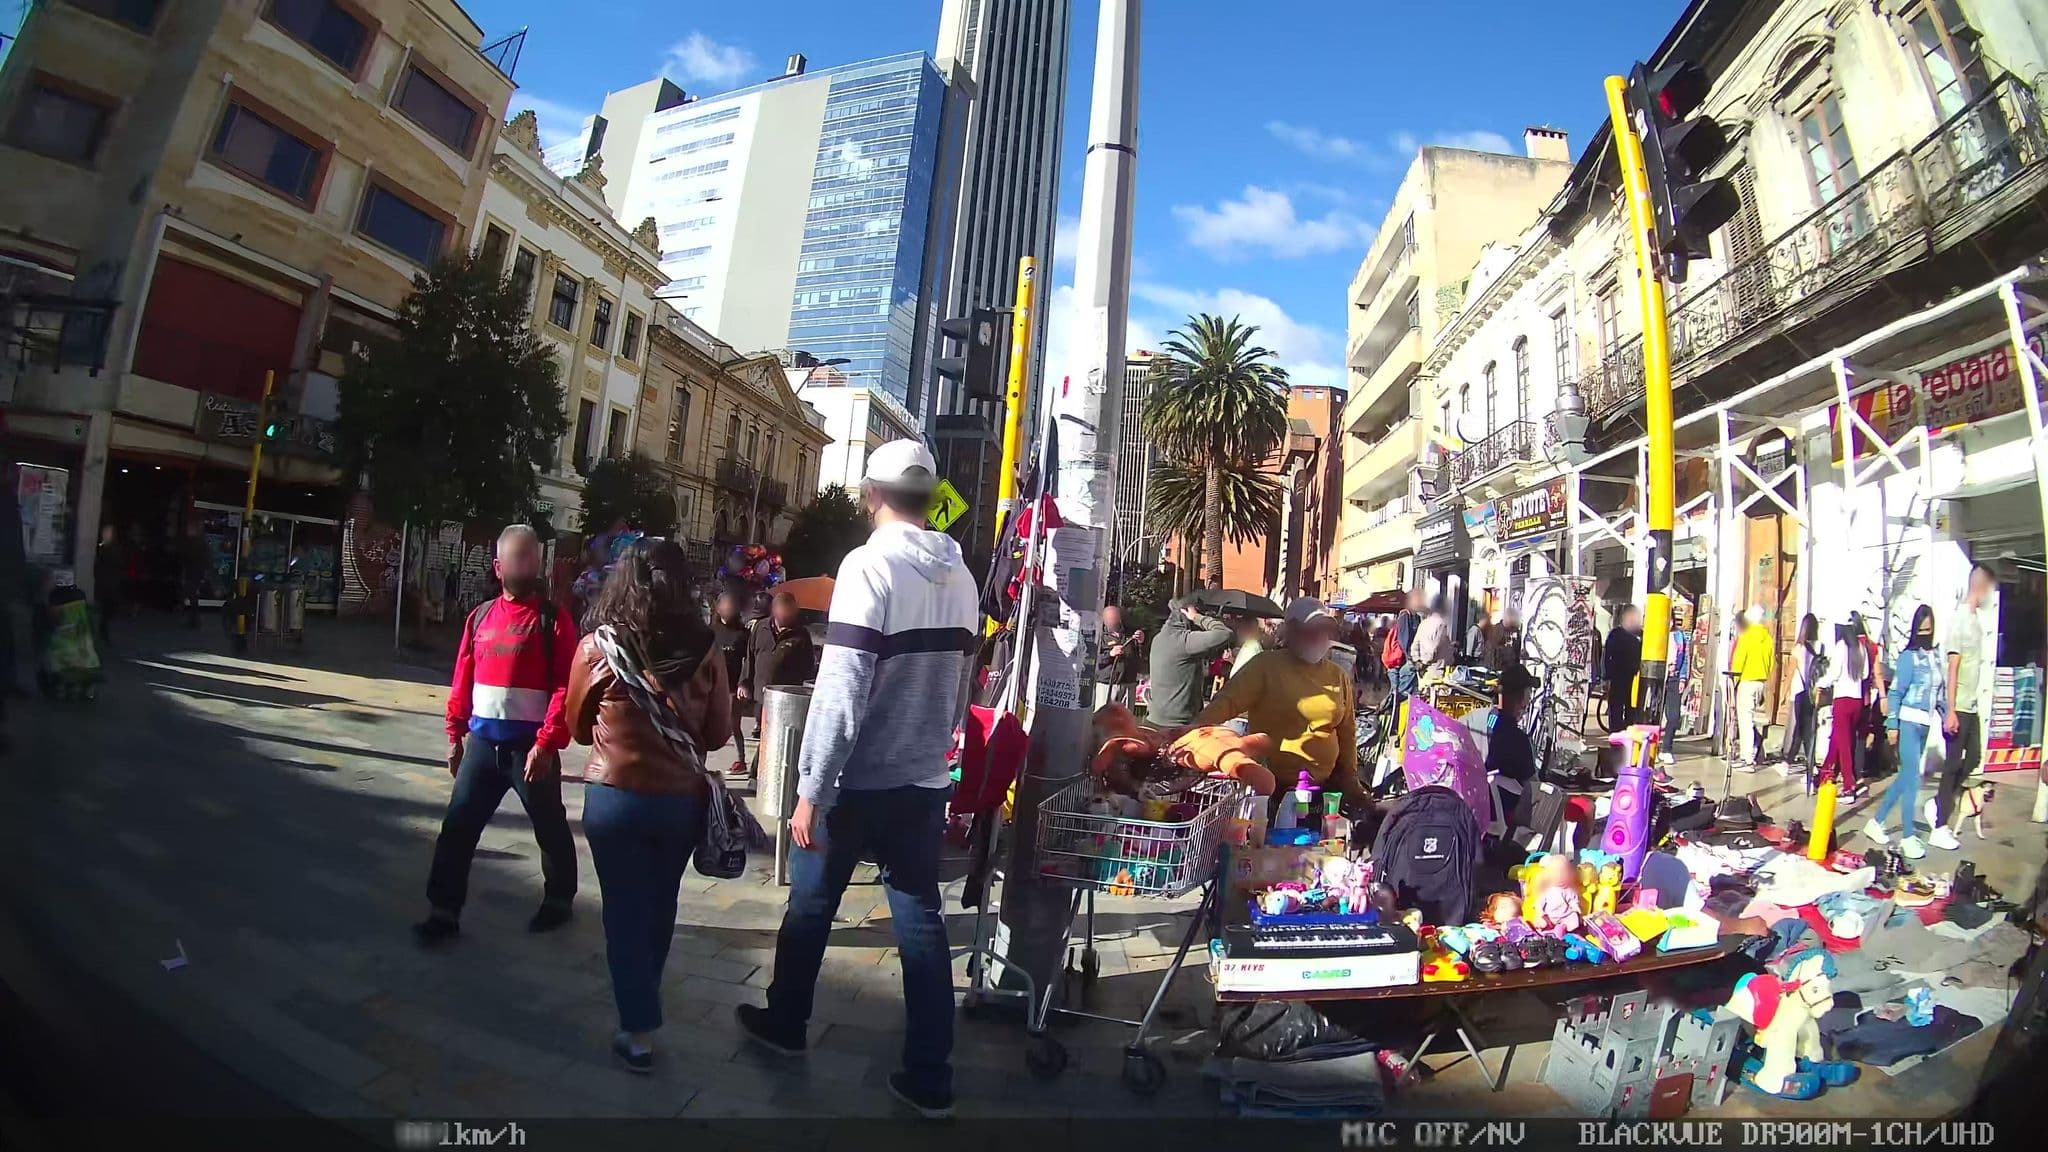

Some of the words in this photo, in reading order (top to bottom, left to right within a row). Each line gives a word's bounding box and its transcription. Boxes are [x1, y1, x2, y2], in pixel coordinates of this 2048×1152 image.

[1887, 383, 1915, 419] la
[1223, 964, 1236, 972] 37
[1240, 963, 1265, 973] KEYS
